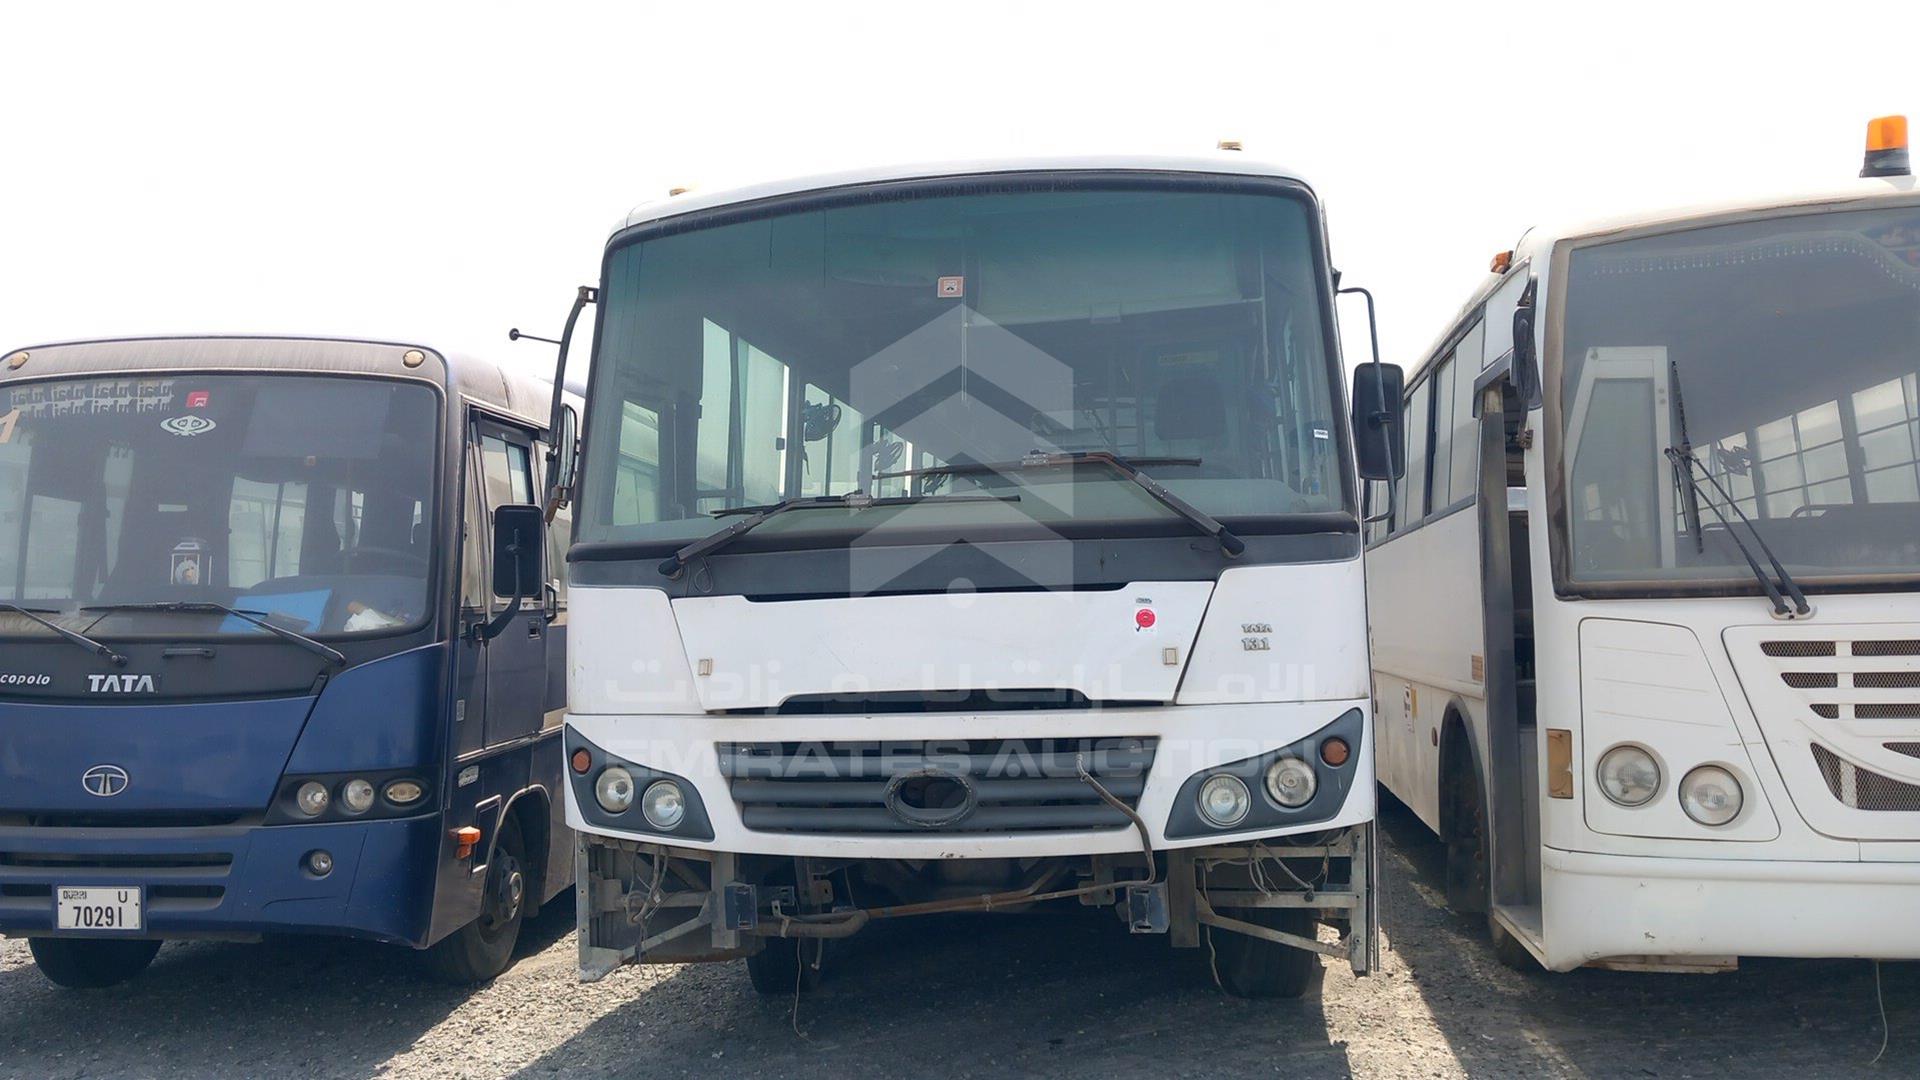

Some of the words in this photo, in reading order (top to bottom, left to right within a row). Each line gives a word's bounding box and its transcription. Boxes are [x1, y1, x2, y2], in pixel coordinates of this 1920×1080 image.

[1241, 624, 1272, 633] TATA
[0, 674, 50, 685] copolo
[88, 675, 154, 692] TATA
[118, 891, 128, 903] U
[73, 906, 122, 927] 70291
